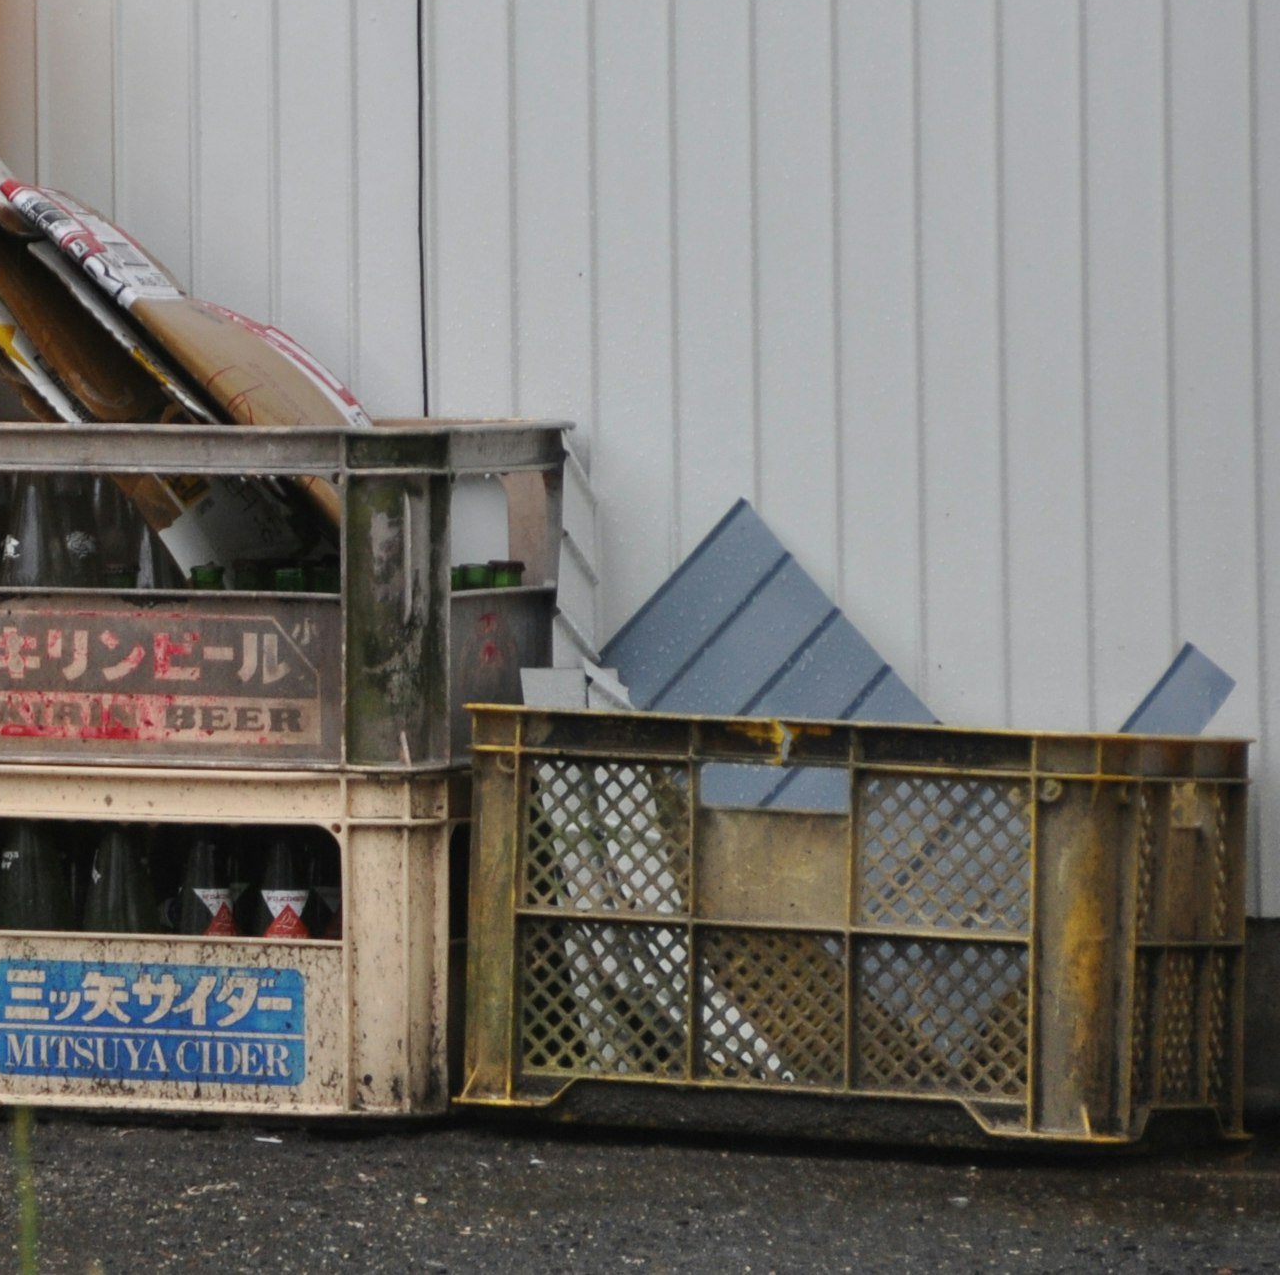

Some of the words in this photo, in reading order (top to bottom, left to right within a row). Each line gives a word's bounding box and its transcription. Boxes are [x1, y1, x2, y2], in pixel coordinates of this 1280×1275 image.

[165, 704, 305, 732] BEER
[4, 1033, 170, 1072] MITSUYA
[176, 1039, 292, 1077] CIDER
